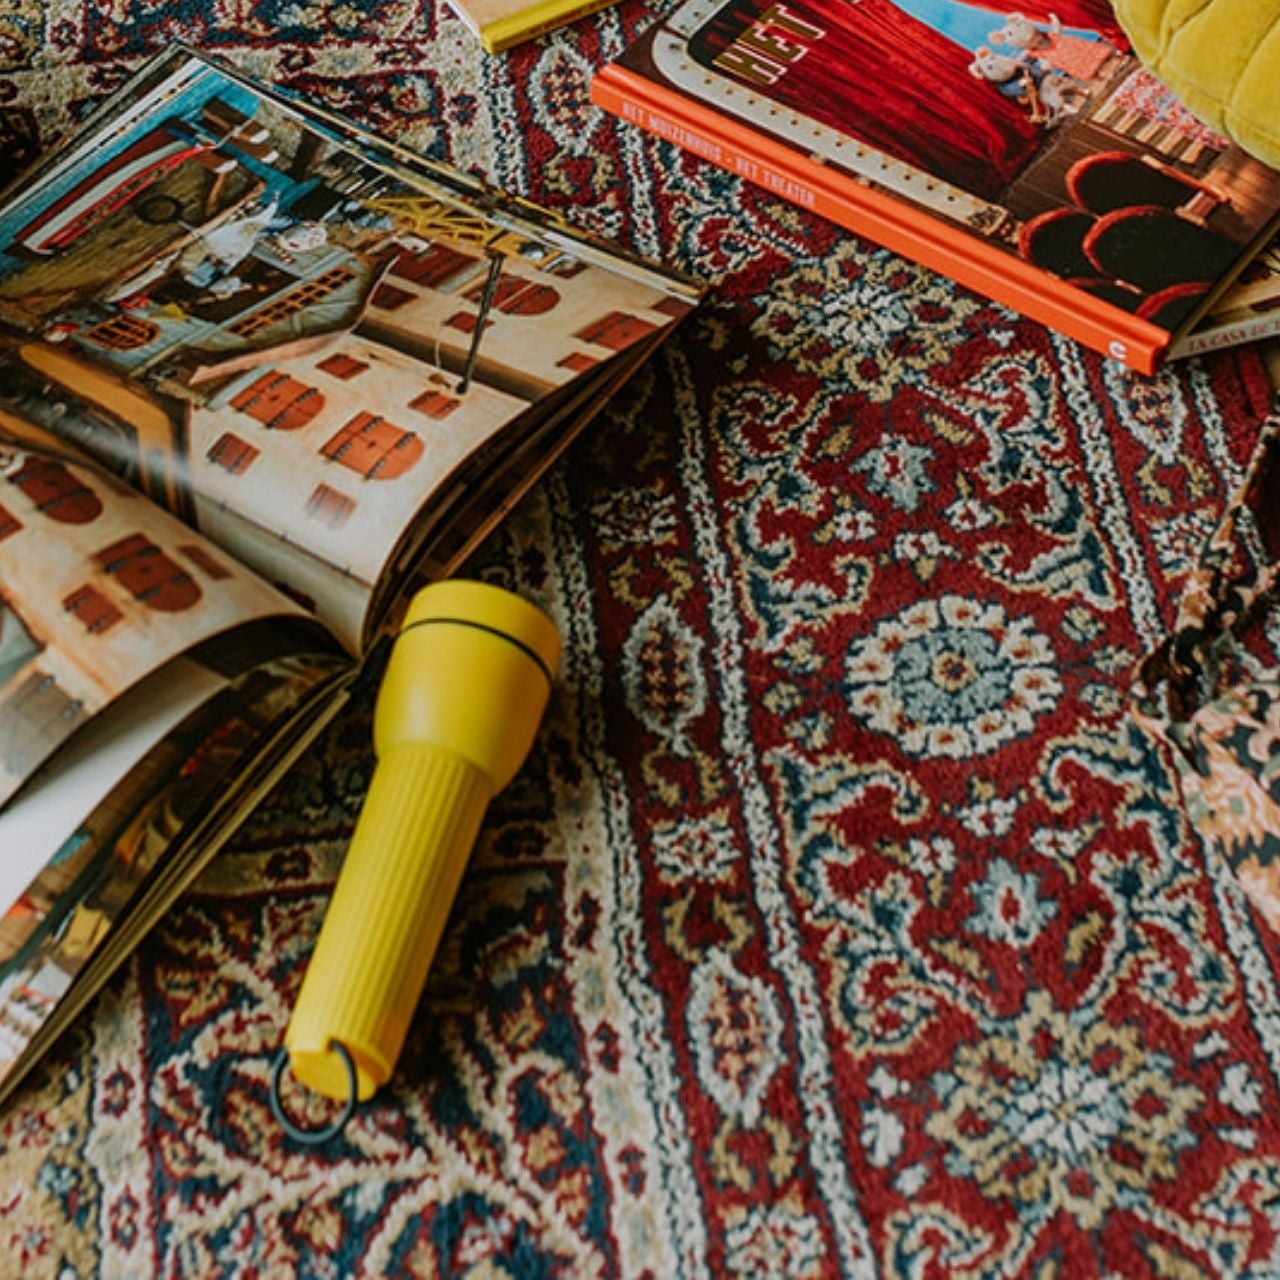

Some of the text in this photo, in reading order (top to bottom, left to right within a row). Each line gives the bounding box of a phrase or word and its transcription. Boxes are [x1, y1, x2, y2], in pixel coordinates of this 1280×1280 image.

[711, 3, 827, 86] HET
[622, 100, 644, 122] HET
[735, 155, 759, 178] HET
[763, 167, 816, 208] THEATER
